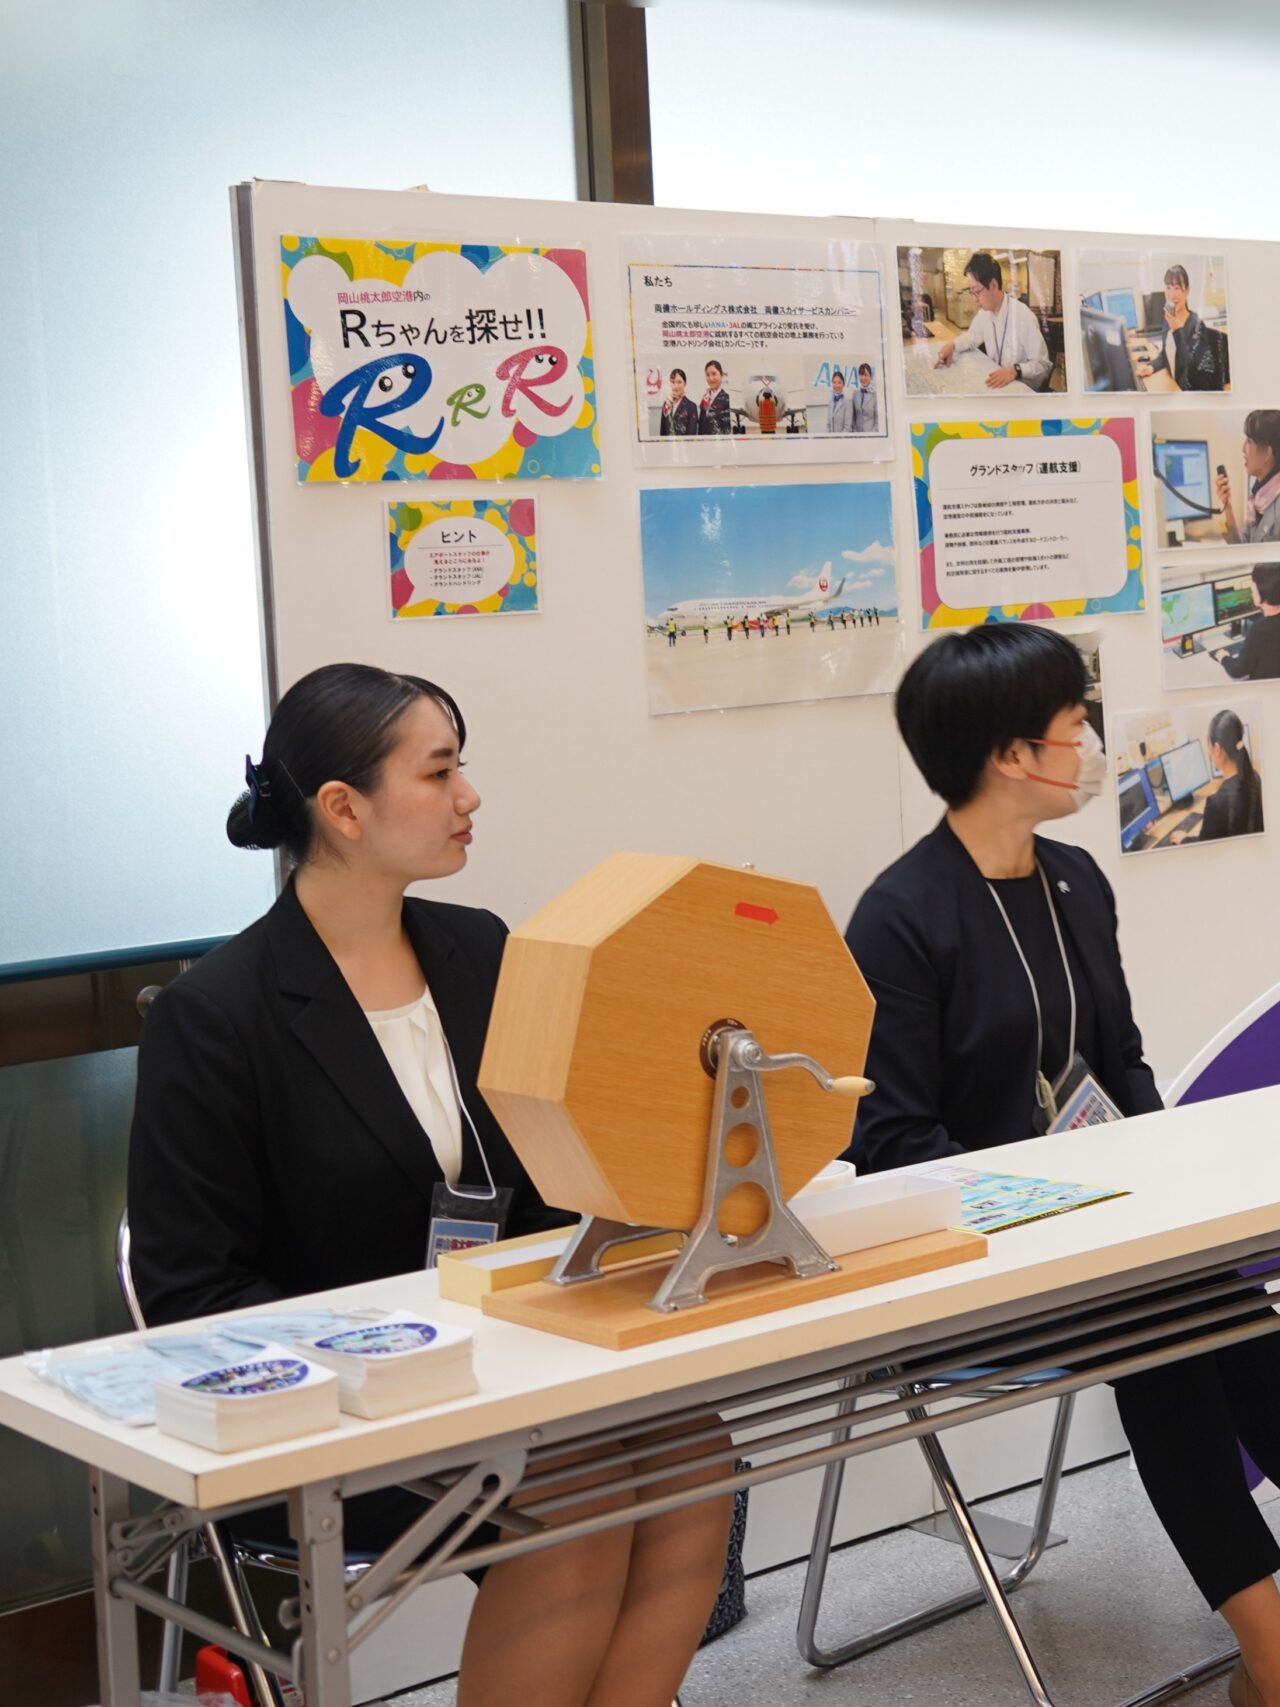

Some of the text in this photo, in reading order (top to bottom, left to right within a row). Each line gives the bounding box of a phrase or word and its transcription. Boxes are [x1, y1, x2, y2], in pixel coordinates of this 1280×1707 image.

[644, 275, 673, 287] 私たち
[337, 290, 431, 304] 岡山桃太郎空港内の
[441, 529, 477, 543] ヒント
